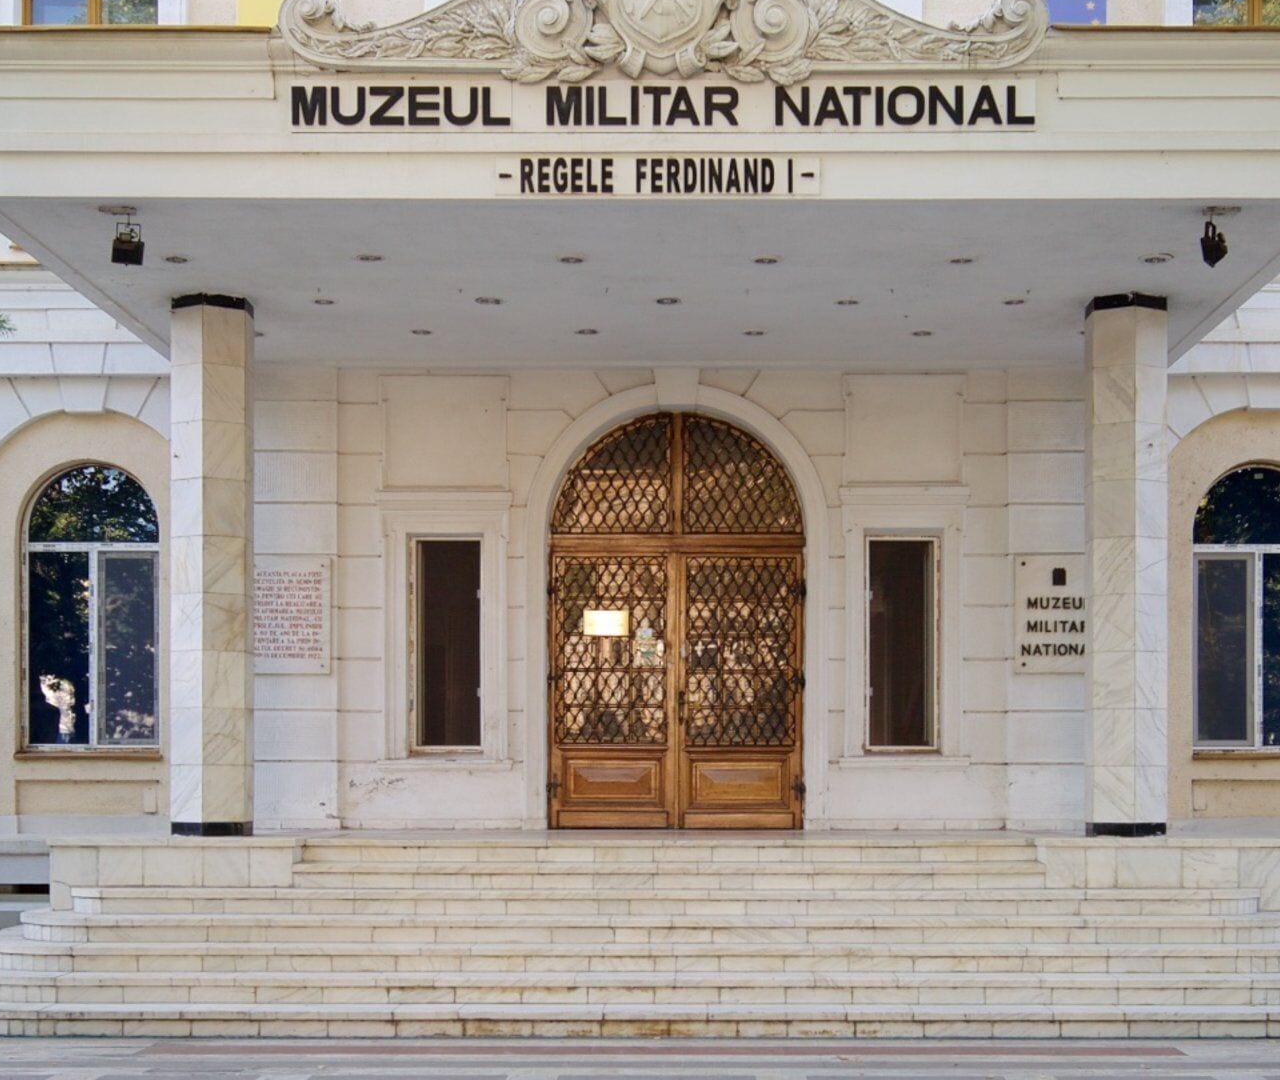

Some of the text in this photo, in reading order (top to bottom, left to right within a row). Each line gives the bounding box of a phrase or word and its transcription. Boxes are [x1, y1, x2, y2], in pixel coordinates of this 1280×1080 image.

[291, 85, 1036, 127] MUZEUL MILITAR NATIONAL
[635, 157, 776, 195] FERDINAND
[1026, 596, 1086, 611] MUZEU
